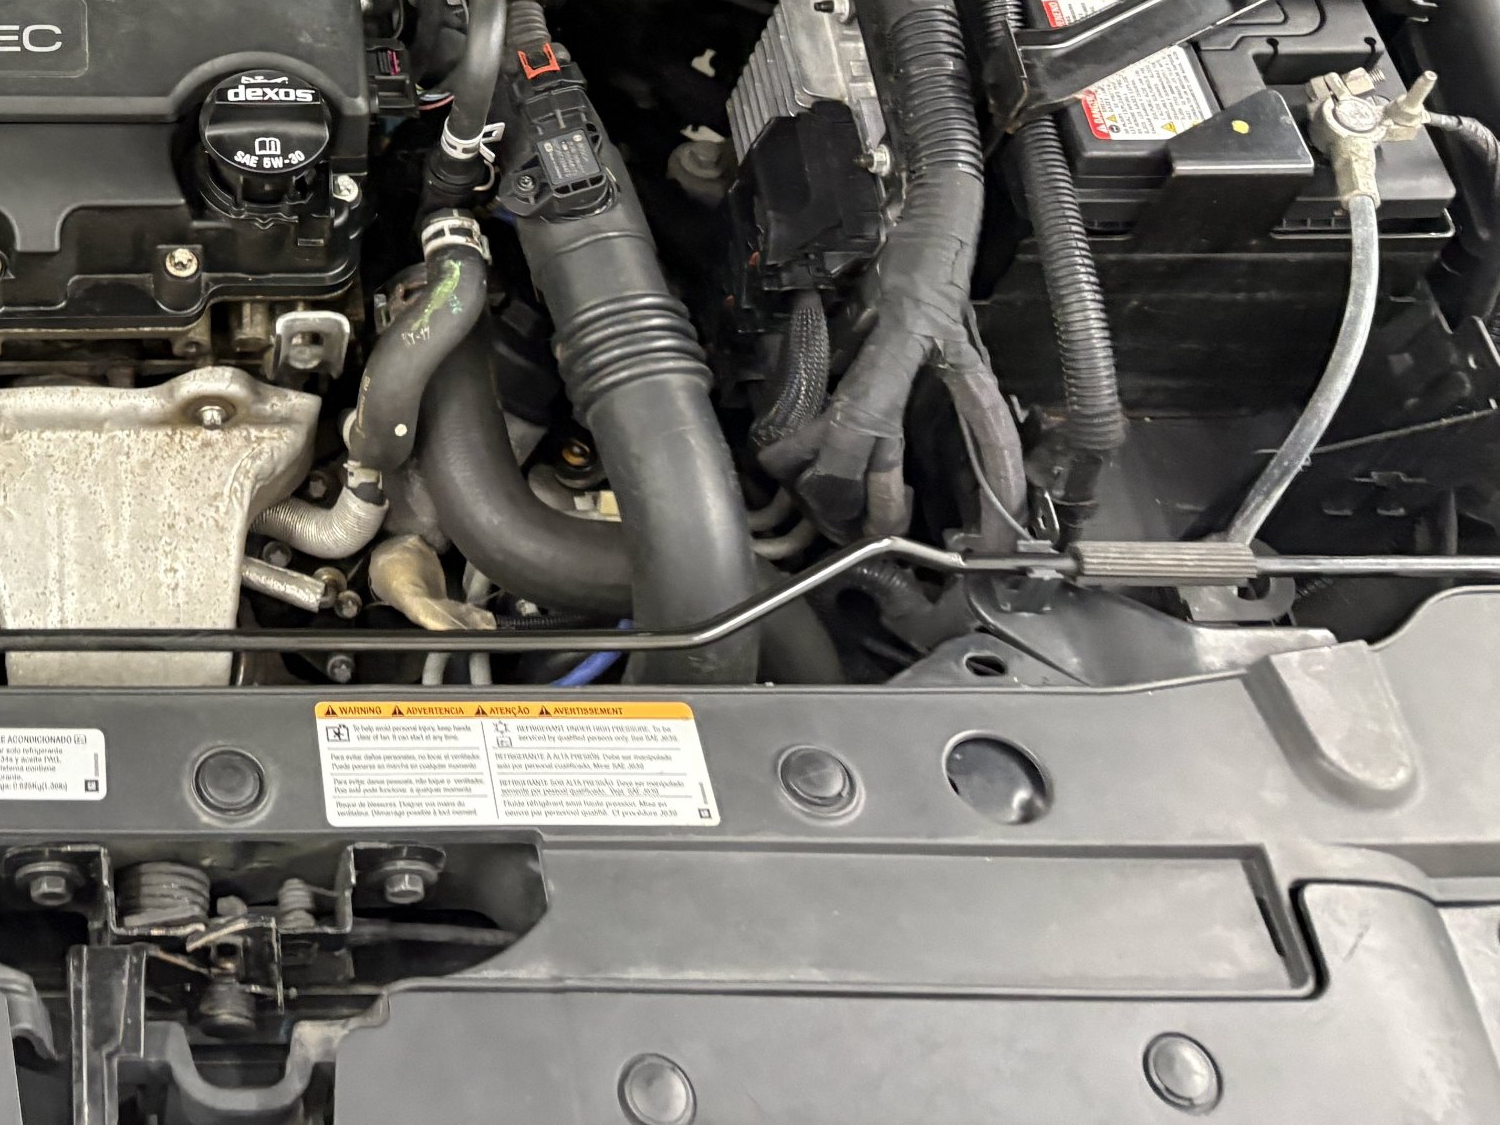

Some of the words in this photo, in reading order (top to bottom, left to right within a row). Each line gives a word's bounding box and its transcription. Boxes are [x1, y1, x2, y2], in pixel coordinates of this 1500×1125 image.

[227, 85, 316, 102] dexos
[234, 150, 259, 168] SAE
[262, 150, 306, 169] 5W-30
[339, 706, 382, 715] WARNING
[406, 706, 464, 715] ADVERTENCIA
[490, 705, 530, 717] ATENÇÃO
[553, 707, 623, 716] AVERTISSEMENT
[7, 735, 72, 744] ACONDICIONADO
